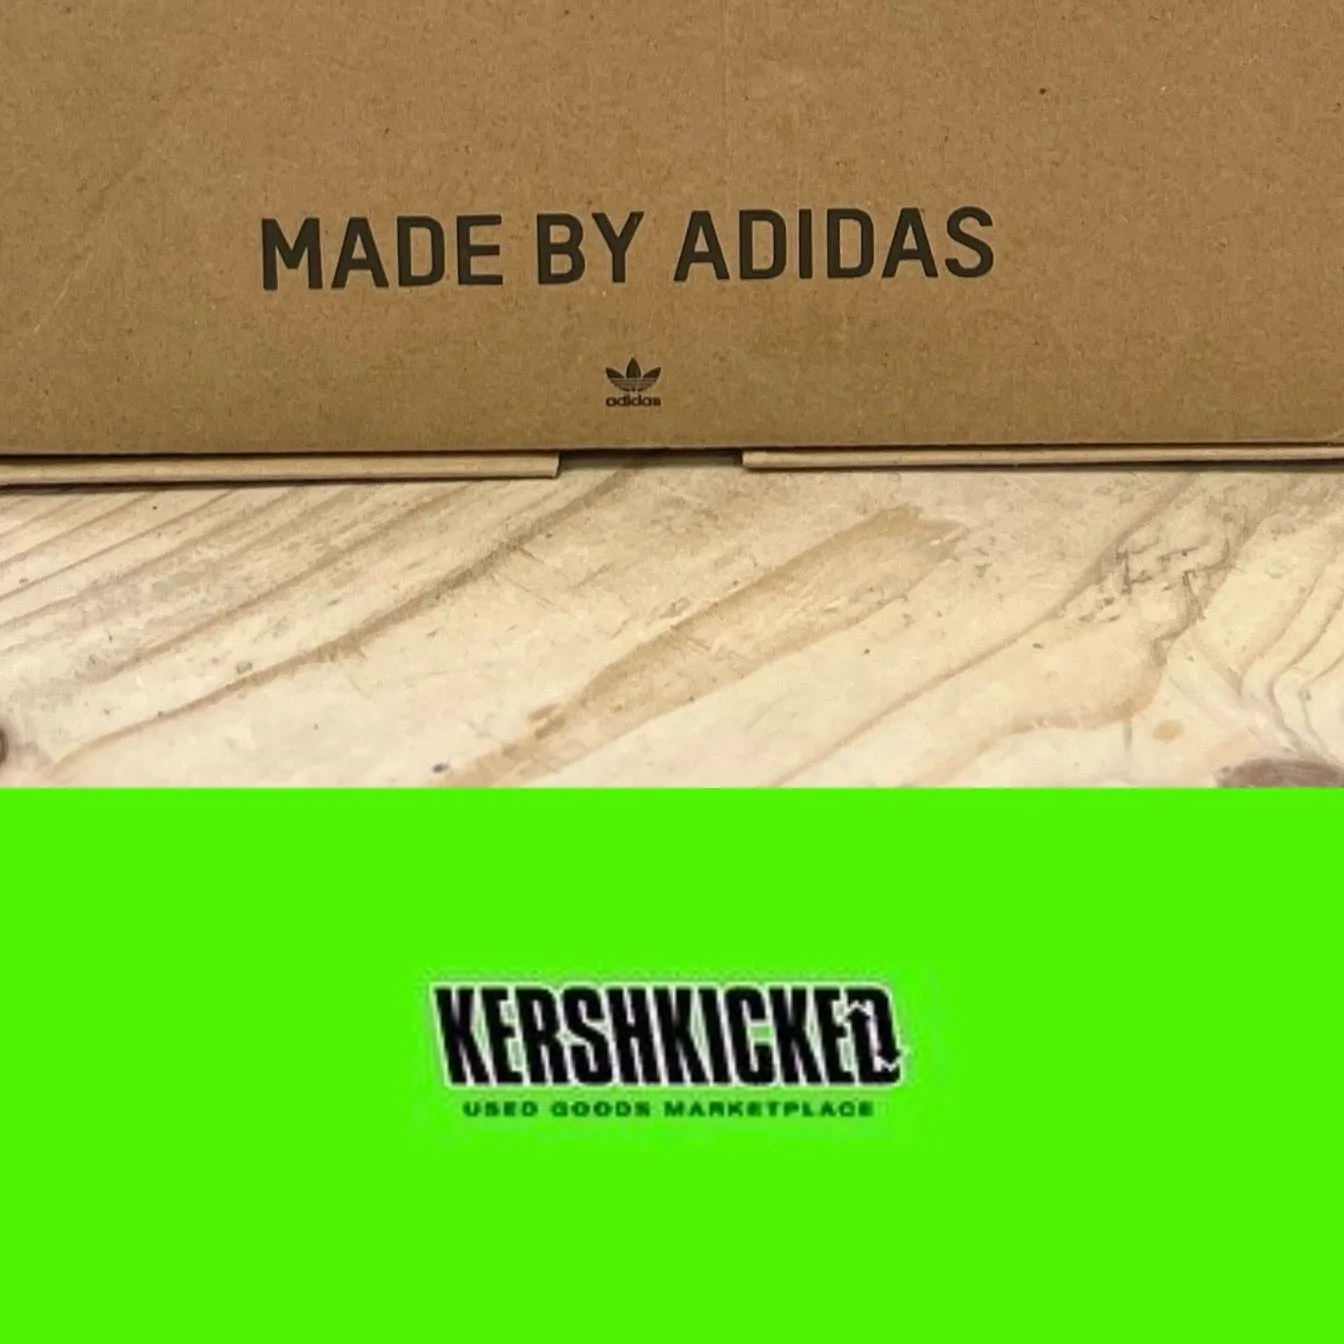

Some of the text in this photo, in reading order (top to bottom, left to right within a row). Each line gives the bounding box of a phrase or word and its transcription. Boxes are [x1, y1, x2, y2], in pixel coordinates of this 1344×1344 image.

[260, 205, 994, 292] MADE BY ADIDAS
[605, 394, 662, 407] adidas
